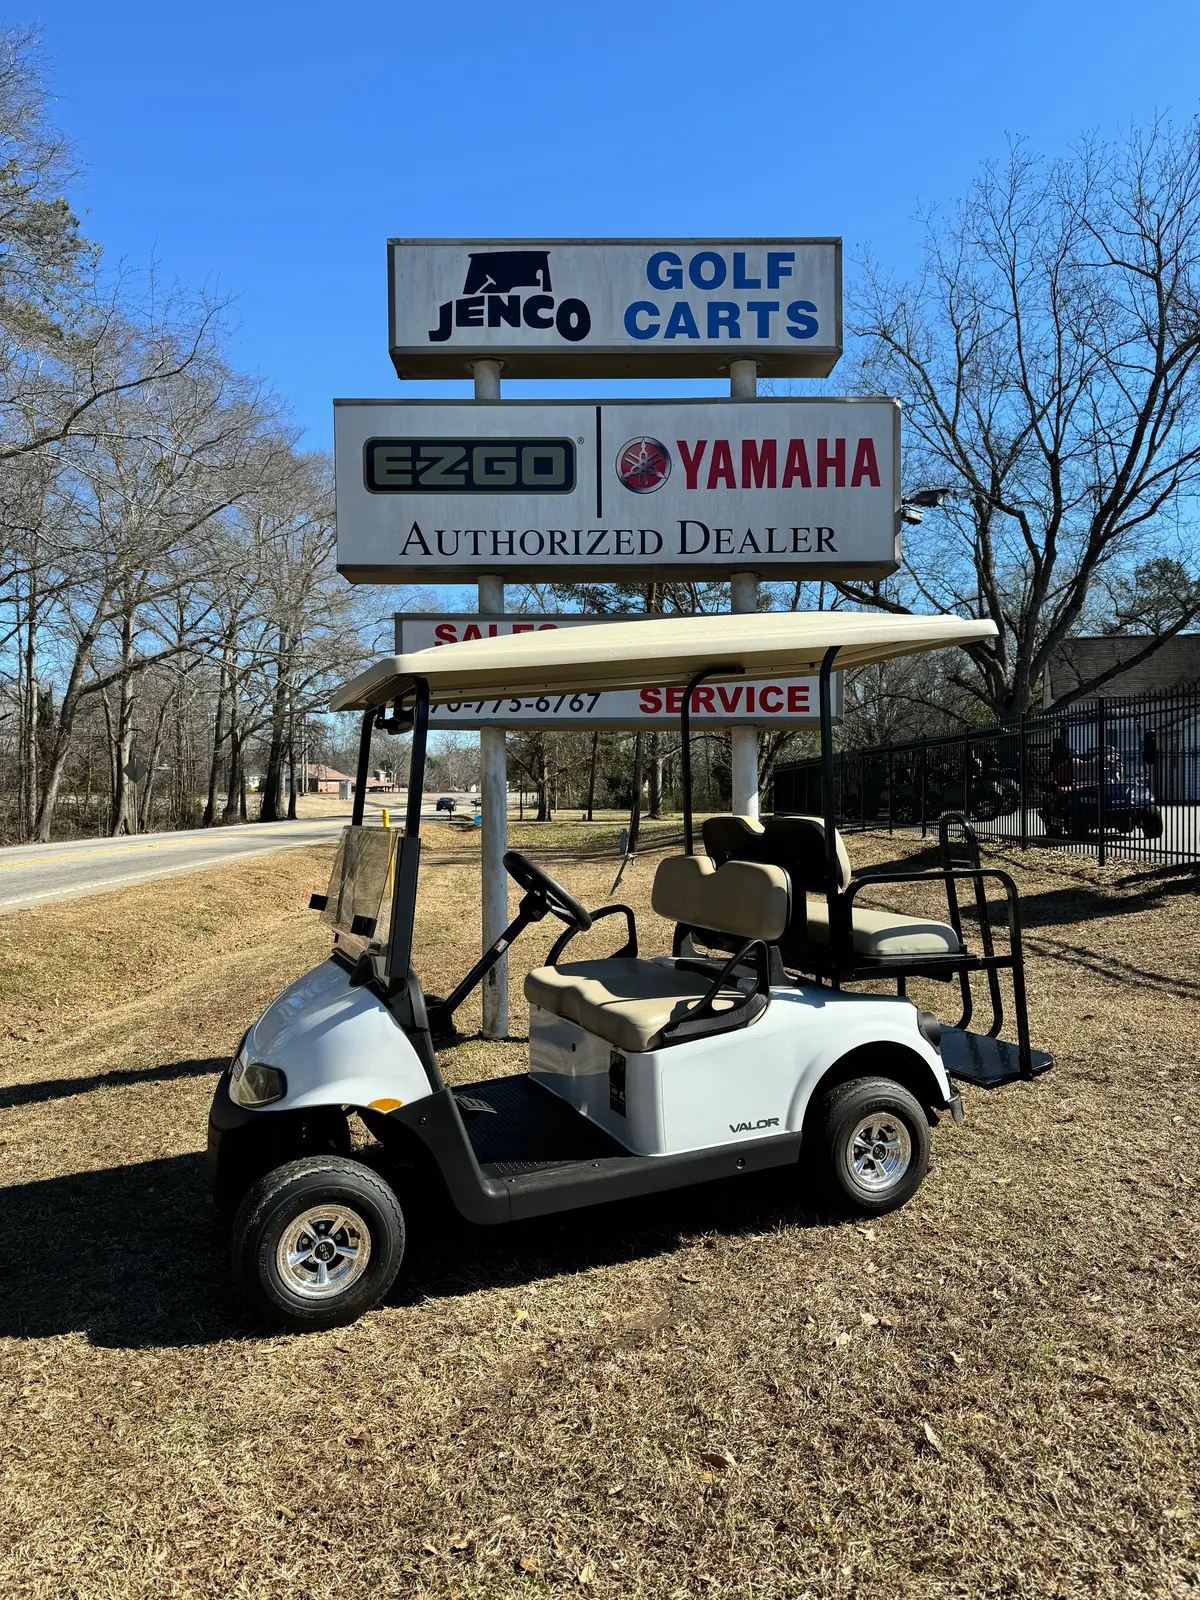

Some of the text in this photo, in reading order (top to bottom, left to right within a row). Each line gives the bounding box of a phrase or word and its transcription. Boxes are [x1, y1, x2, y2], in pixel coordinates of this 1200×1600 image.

[646, 251, 796, 291] GOLF
[428, 294, 591, 342] JENCO
[623, 300, 819, 340] CARTS
[676, 437, 881, 490] YAMAHA
[398, 519, 839, 557] AUTHORIZED DEALER
[434, 623, 559, 647] SAL
[639, 685, 811, 714] SERVICE
[728, 1117, 780, 1134] VALOR
